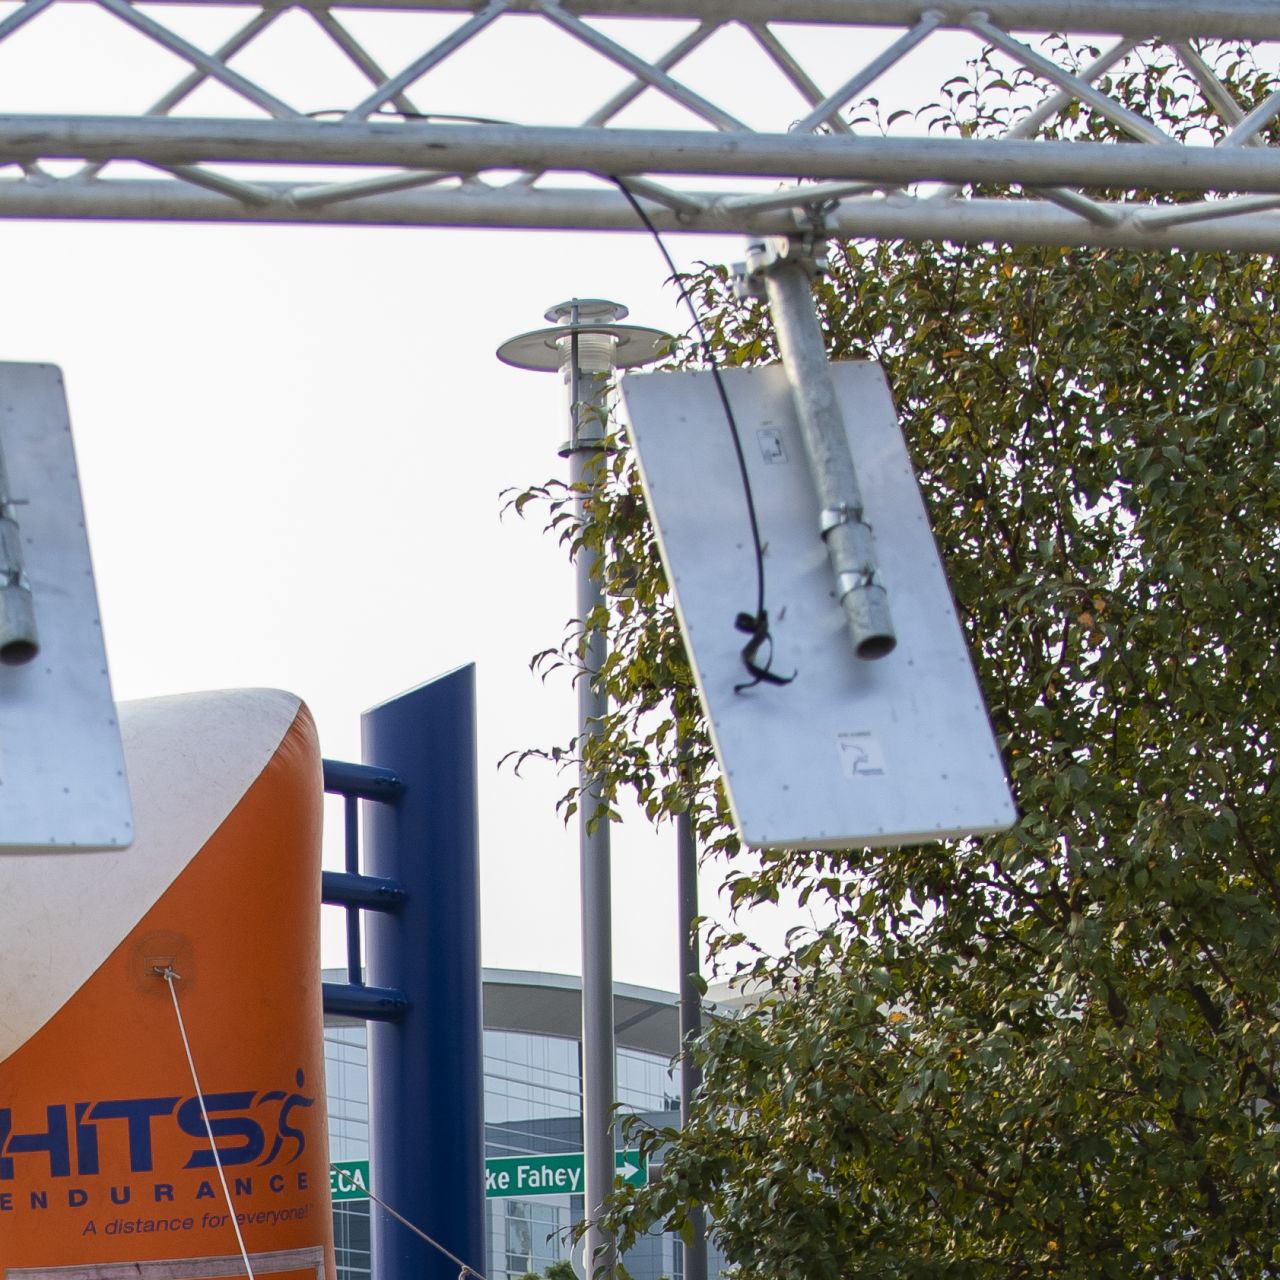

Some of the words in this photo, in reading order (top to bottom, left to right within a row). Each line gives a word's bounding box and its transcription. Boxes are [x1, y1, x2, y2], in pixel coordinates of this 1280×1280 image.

[517, 1165, 581, 1191] Fahey
[0, 1172, 309, 1211] ENDURANCE
[82, 1218, 97, 1236] A
[105, 1215, 194, 1234] distance
[202, 1211, 228, 1228] for
